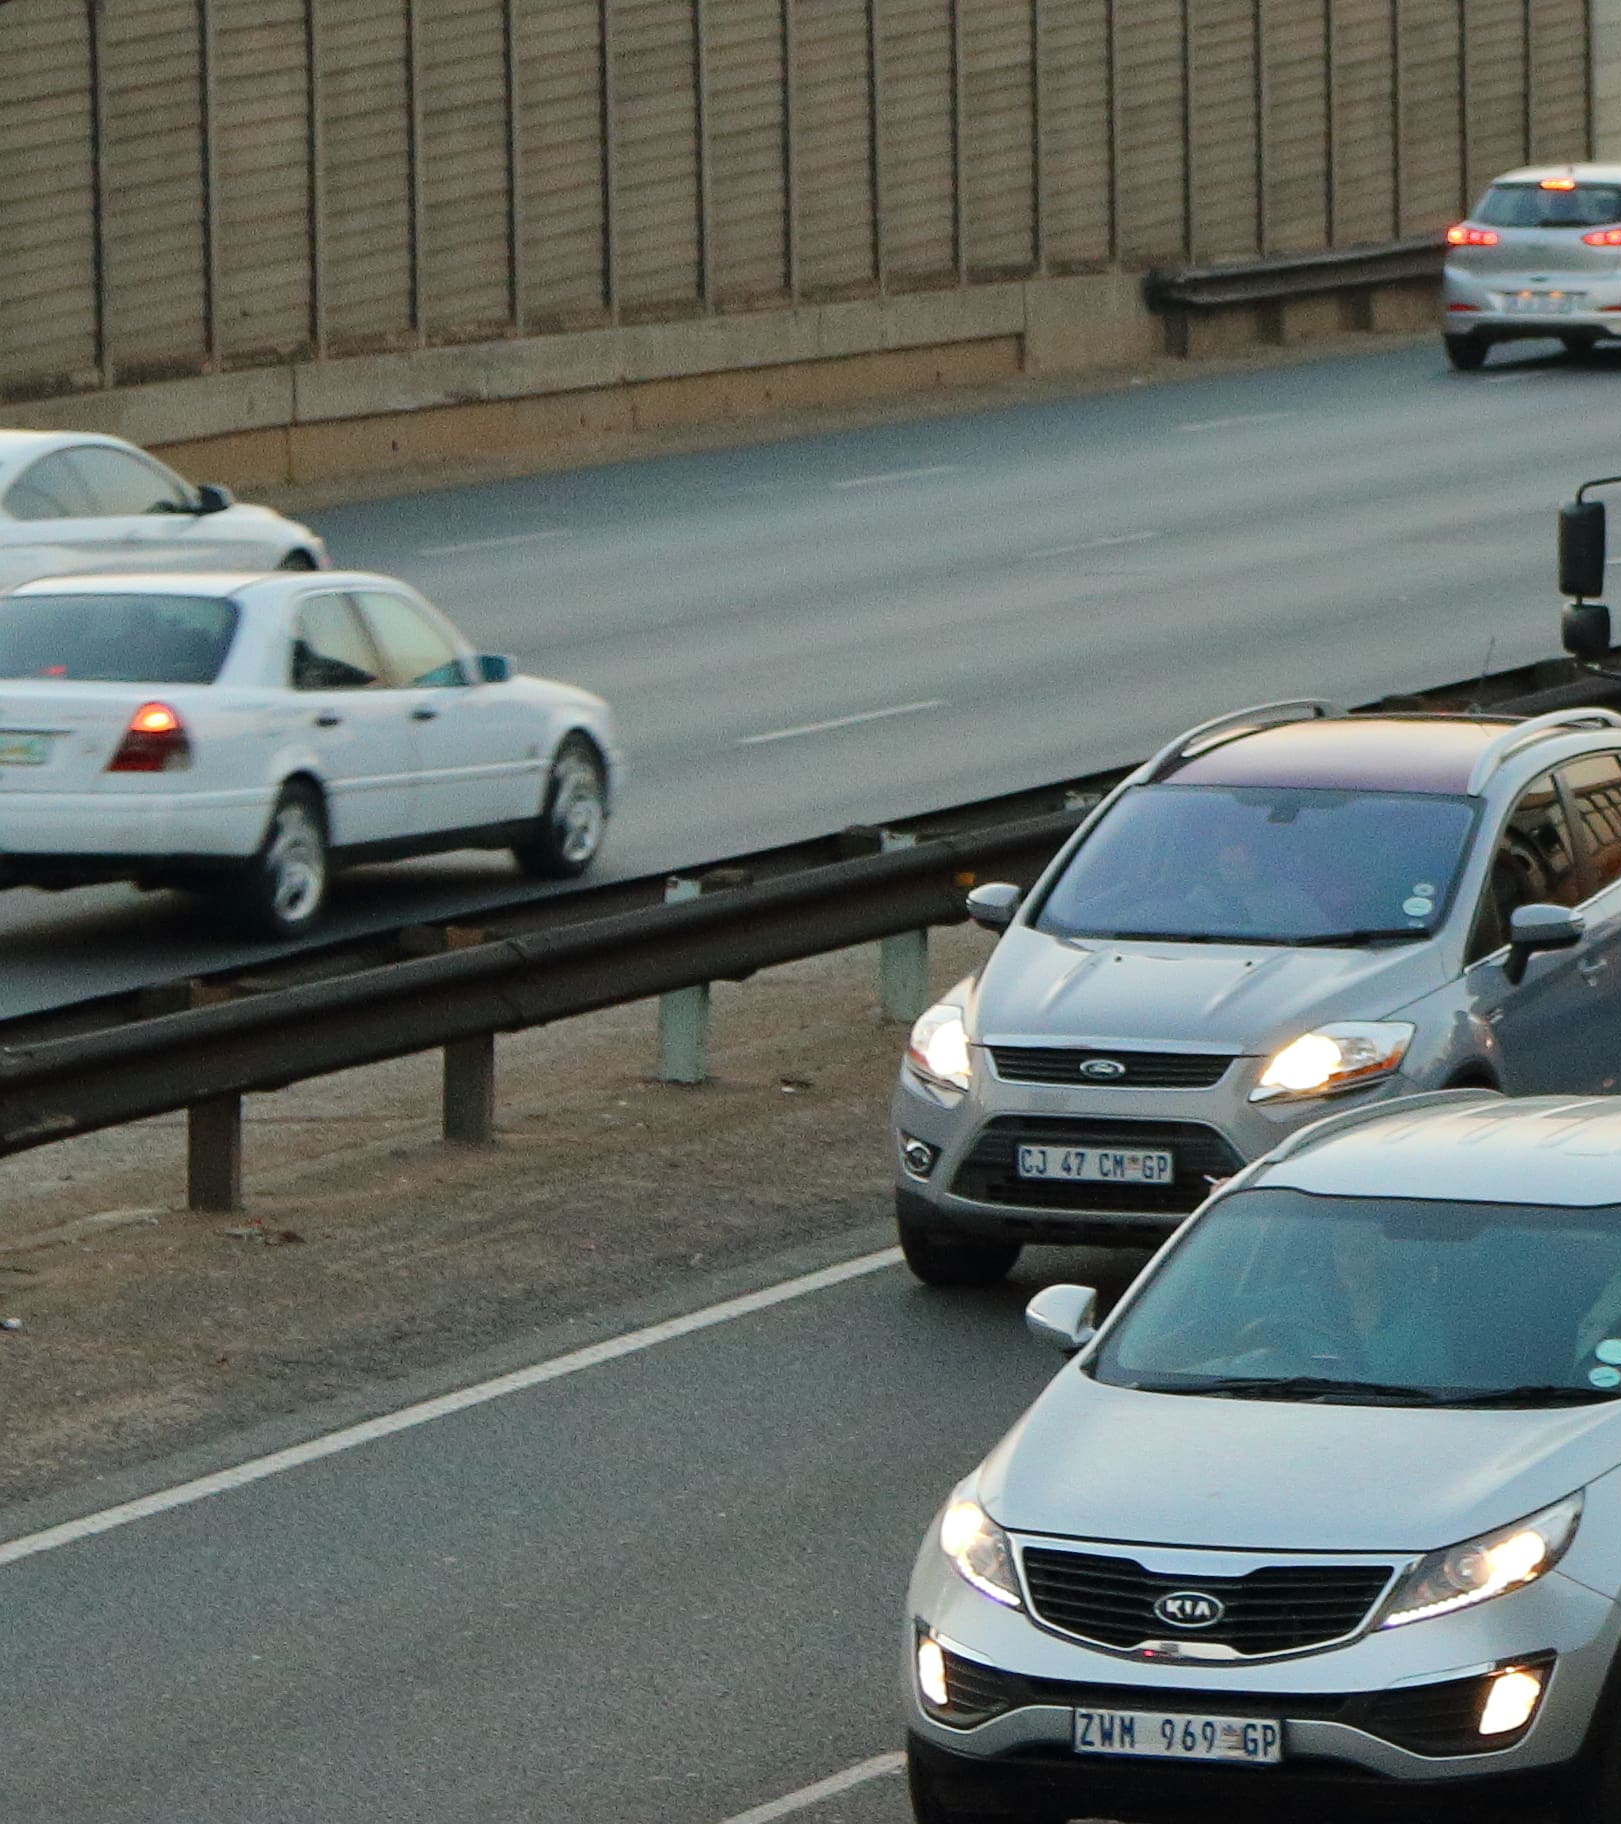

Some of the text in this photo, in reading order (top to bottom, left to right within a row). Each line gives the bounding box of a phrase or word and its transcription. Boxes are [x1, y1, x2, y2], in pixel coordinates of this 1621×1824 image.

[1020, 1148, 1169, 1180] CJ 47 CM GP
[1165, 1599, 1211, 1619] KIA
[1079, 1713, 1277, 1757] ZWM 969 GP
